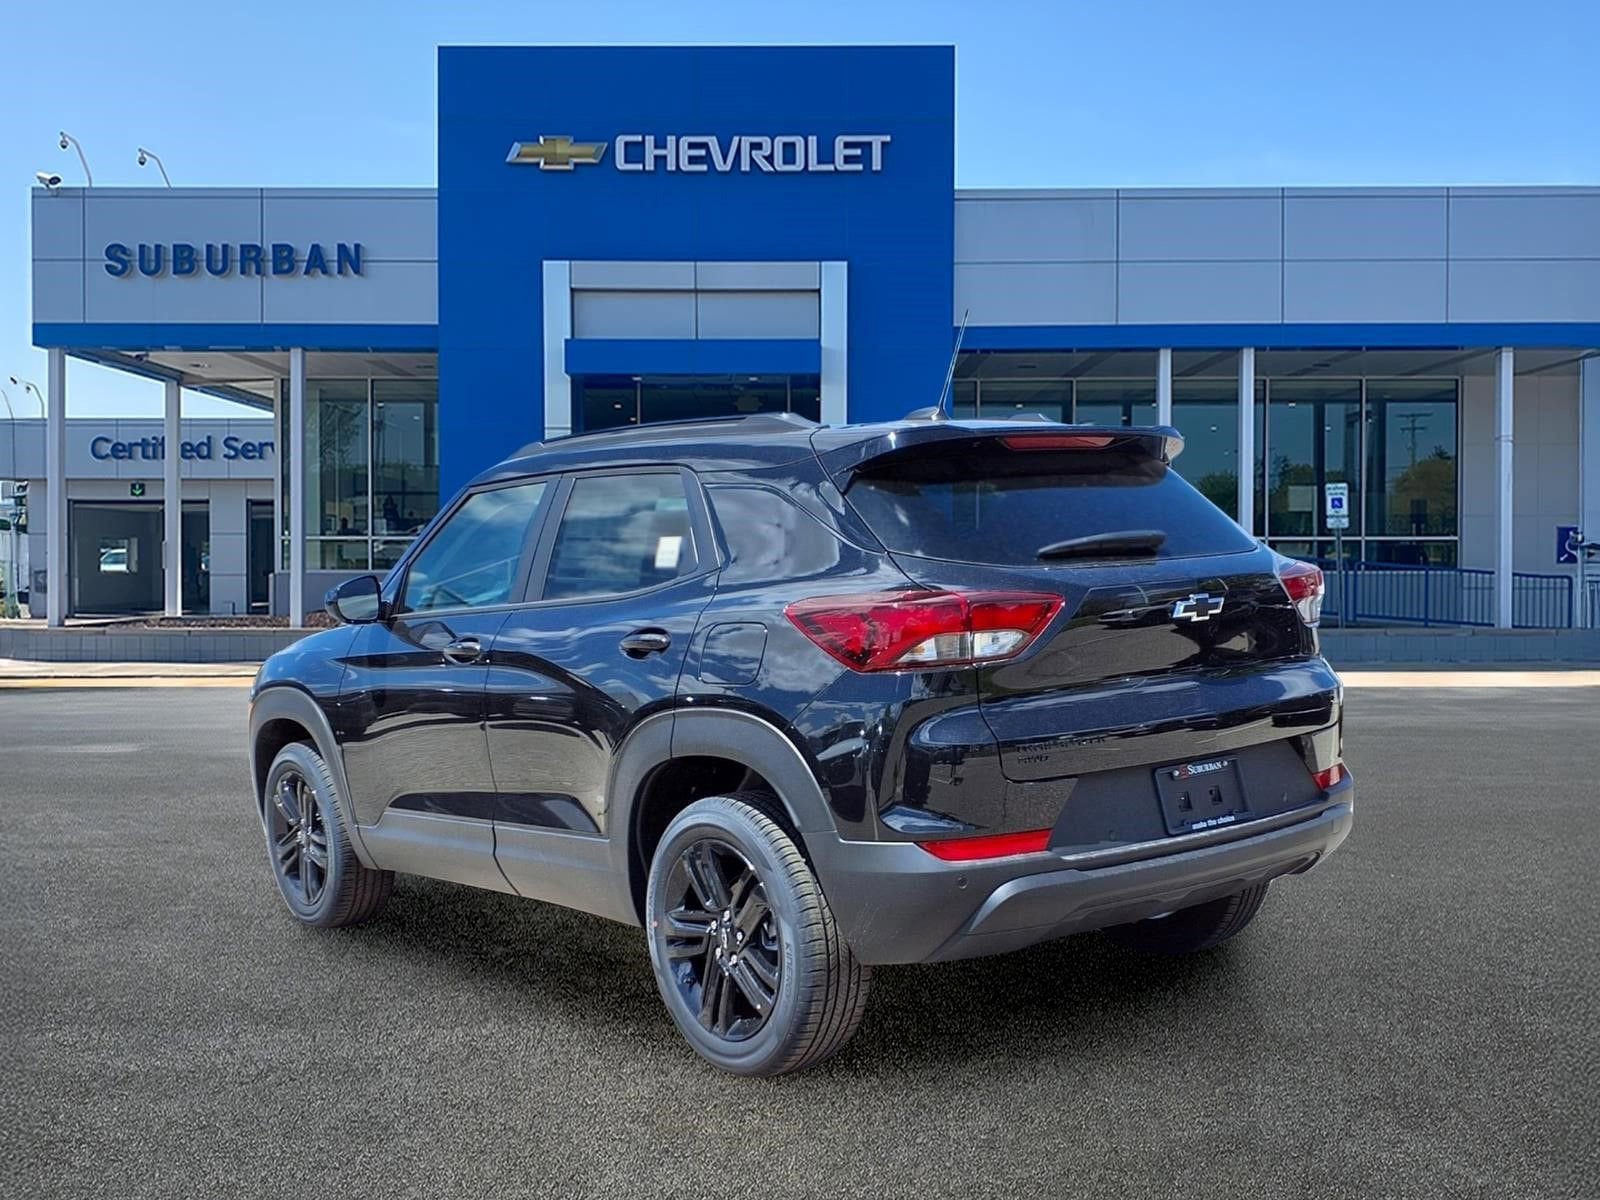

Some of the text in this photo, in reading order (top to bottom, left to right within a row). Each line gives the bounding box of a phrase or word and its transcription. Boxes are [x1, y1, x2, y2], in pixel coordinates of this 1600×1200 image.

[614, 134, 892, 173] CHEVROLET
[104, 242, 363, 277] SUBURBAN
[90, 435, 213, 461] Certifed
